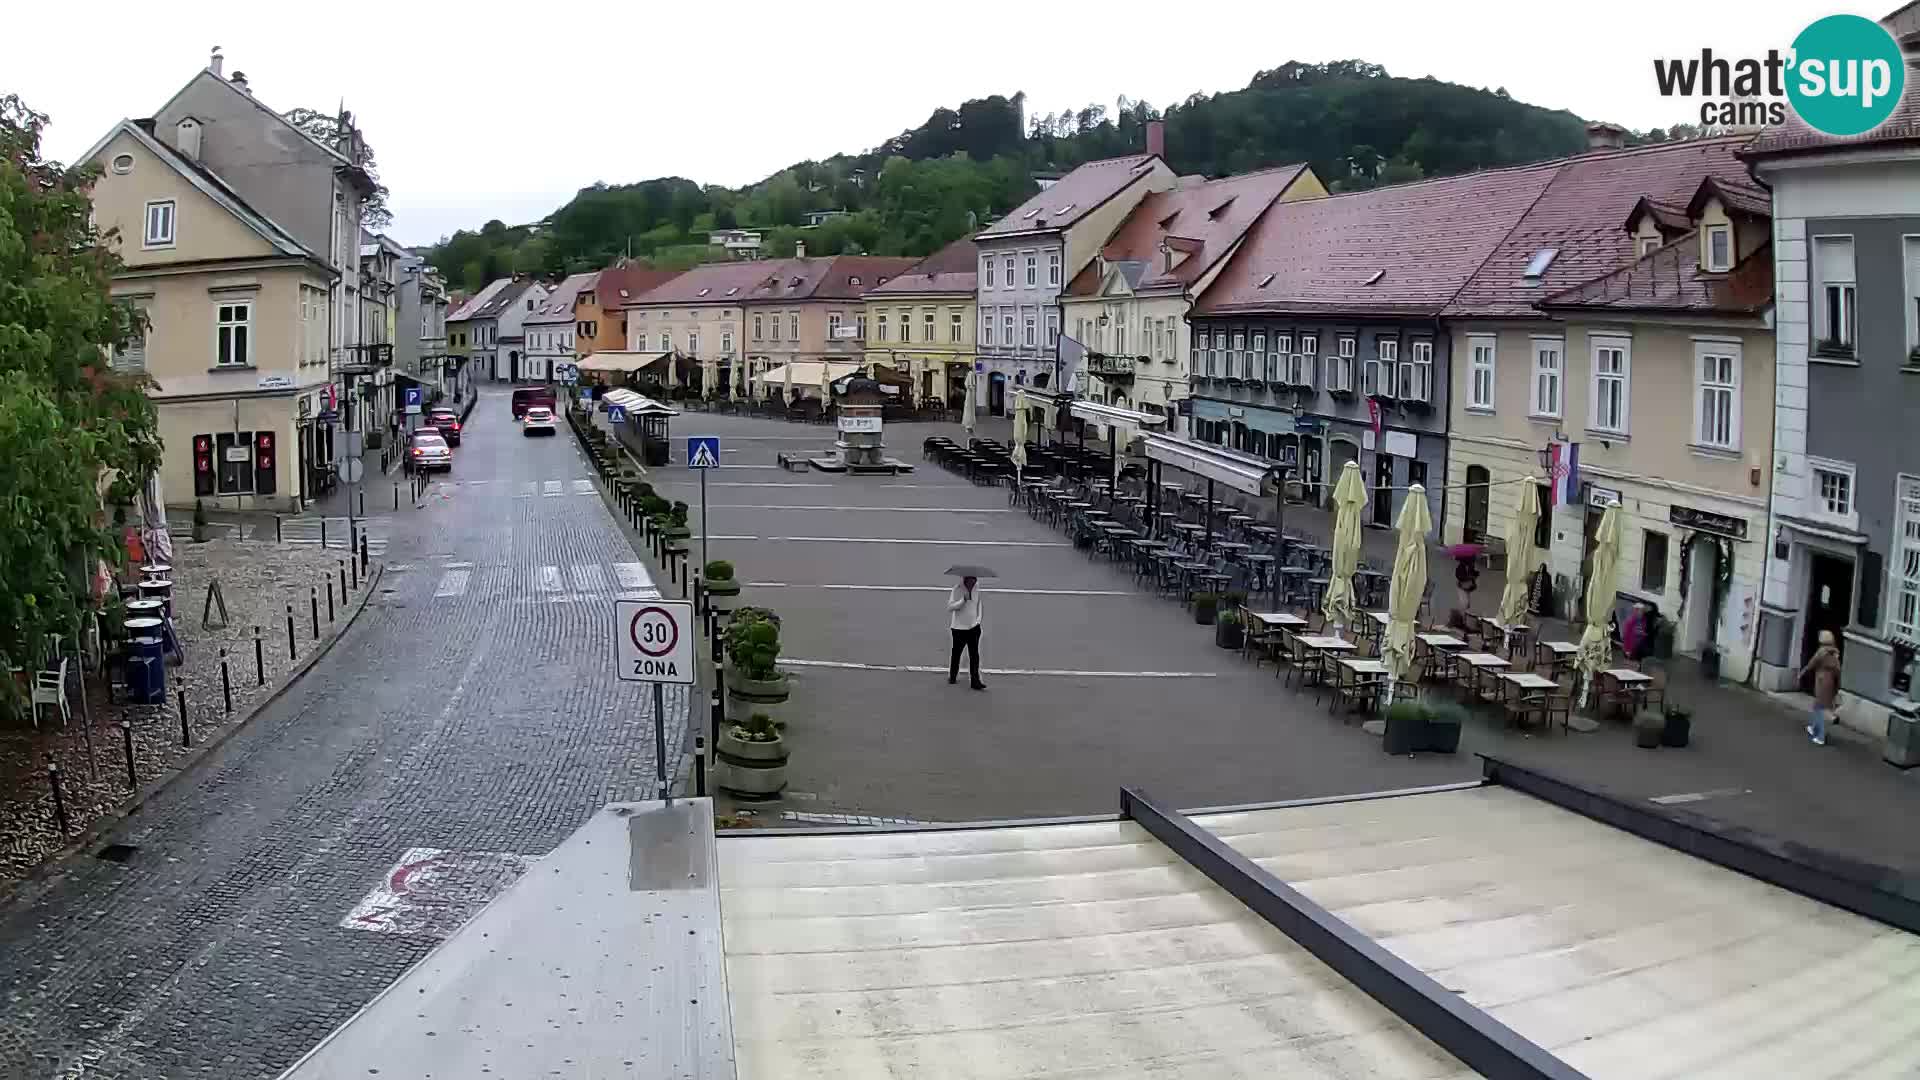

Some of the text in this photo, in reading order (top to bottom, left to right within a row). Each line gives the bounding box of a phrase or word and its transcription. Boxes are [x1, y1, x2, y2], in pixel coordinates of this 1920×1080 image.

[410, 391, 417, 403] P
[643, 622, 667, 643] 30
[633, 659, 678, 677] ZONA
